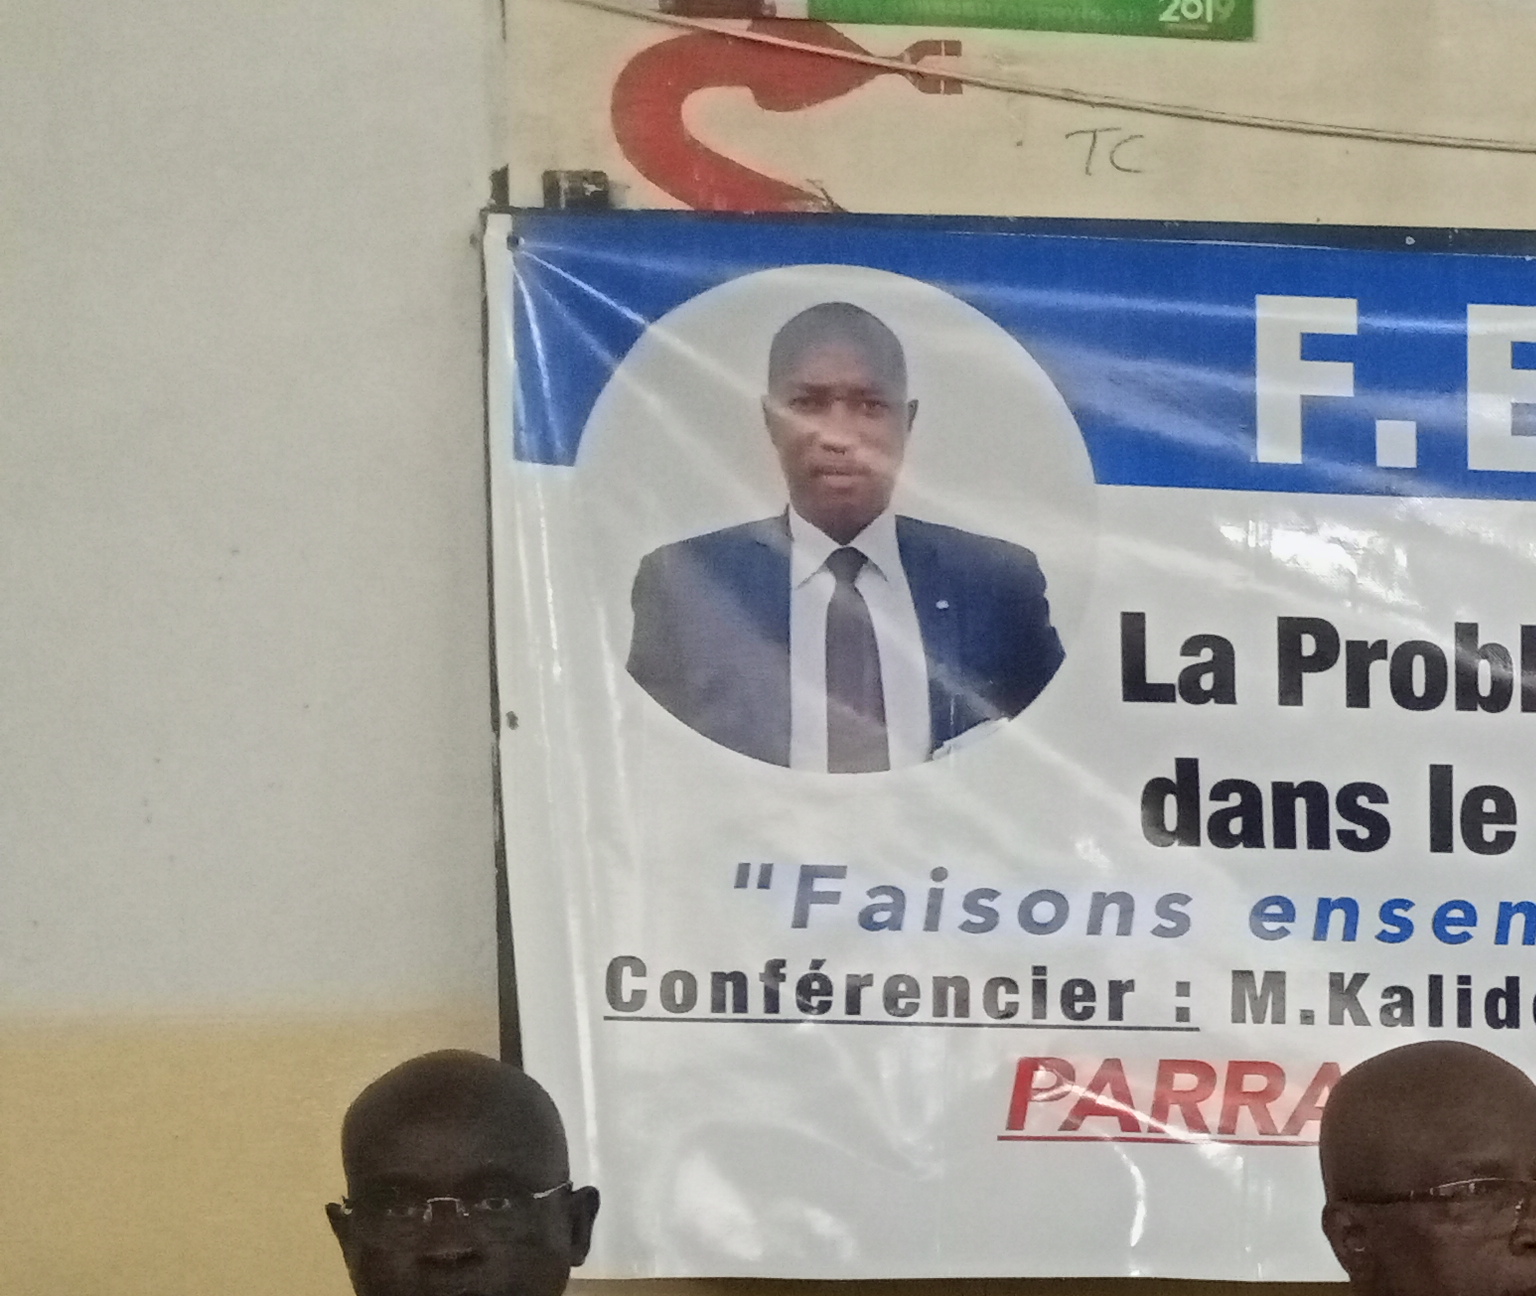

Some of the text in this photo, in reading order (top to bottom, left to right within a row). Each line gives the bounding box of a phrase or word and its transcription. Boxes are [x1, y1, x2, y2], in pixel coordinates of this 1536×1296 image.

[1121, 612, 1236, 706] La
[1140, 758, 1389, 853] dans
[1429, 764, 1516, 855] le
[734, 862, 1192, 938] "Faisons
[605, 955, 1134, 1020] Conférencier
[1005, 1056, 1341, 1135] PARRA
